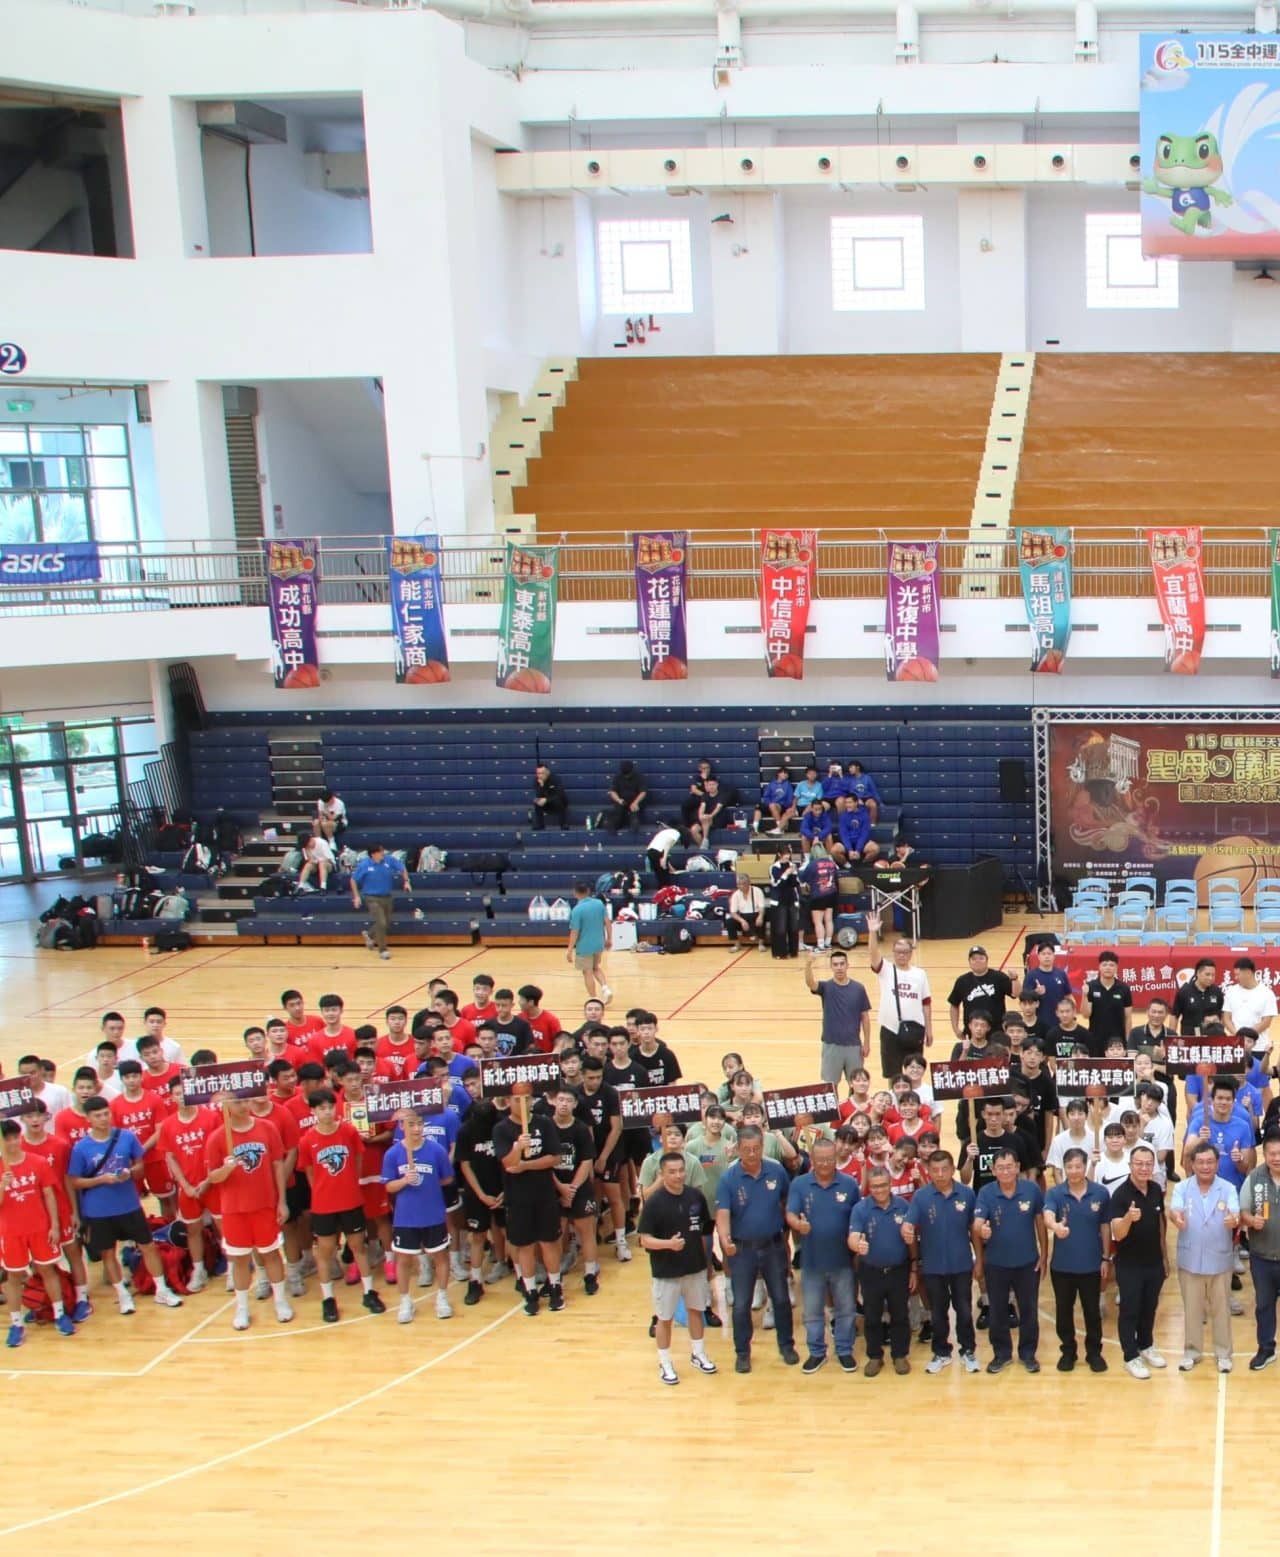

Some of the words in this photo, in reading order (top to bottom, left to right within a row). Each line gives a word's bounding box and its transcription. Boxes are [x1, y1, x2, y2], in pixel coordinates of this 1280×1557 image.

[2, 344, 20, 371] 2
[2, 552, 65, 573] asics
[921, 584, 931, 613] 新竹市
[279, 585, 304, 670] 成功高中
[400, 580, 427, 667] 能仁家商
[647, 577, 671, 663] 花蓮體中
[769, 576, 792, 661] 中信高中
[896, 585, 919, 663] 光復中學
[1163, 575, 1194, 654] 宜蘭高中
[508, 589, 536, 673] 東泰高中
[1145, 981, 1176, 991] Council
[1167, 1045, 1245, 1064] 連江縣馬祖高中
[183, 1071, 265, 1096] 新竹市光復高中
[483, 1063, 560, 1087] 新北市錦和高中
[933, 1067, 1010, 1090] 新北市中信高中
[1056, 1068, 1134, 1086] 新北市永平高中
[367, 1088, 442, 1112] 新北市能仁家商
[622, 1093, 700, 1117] 新北市莊敬高職
